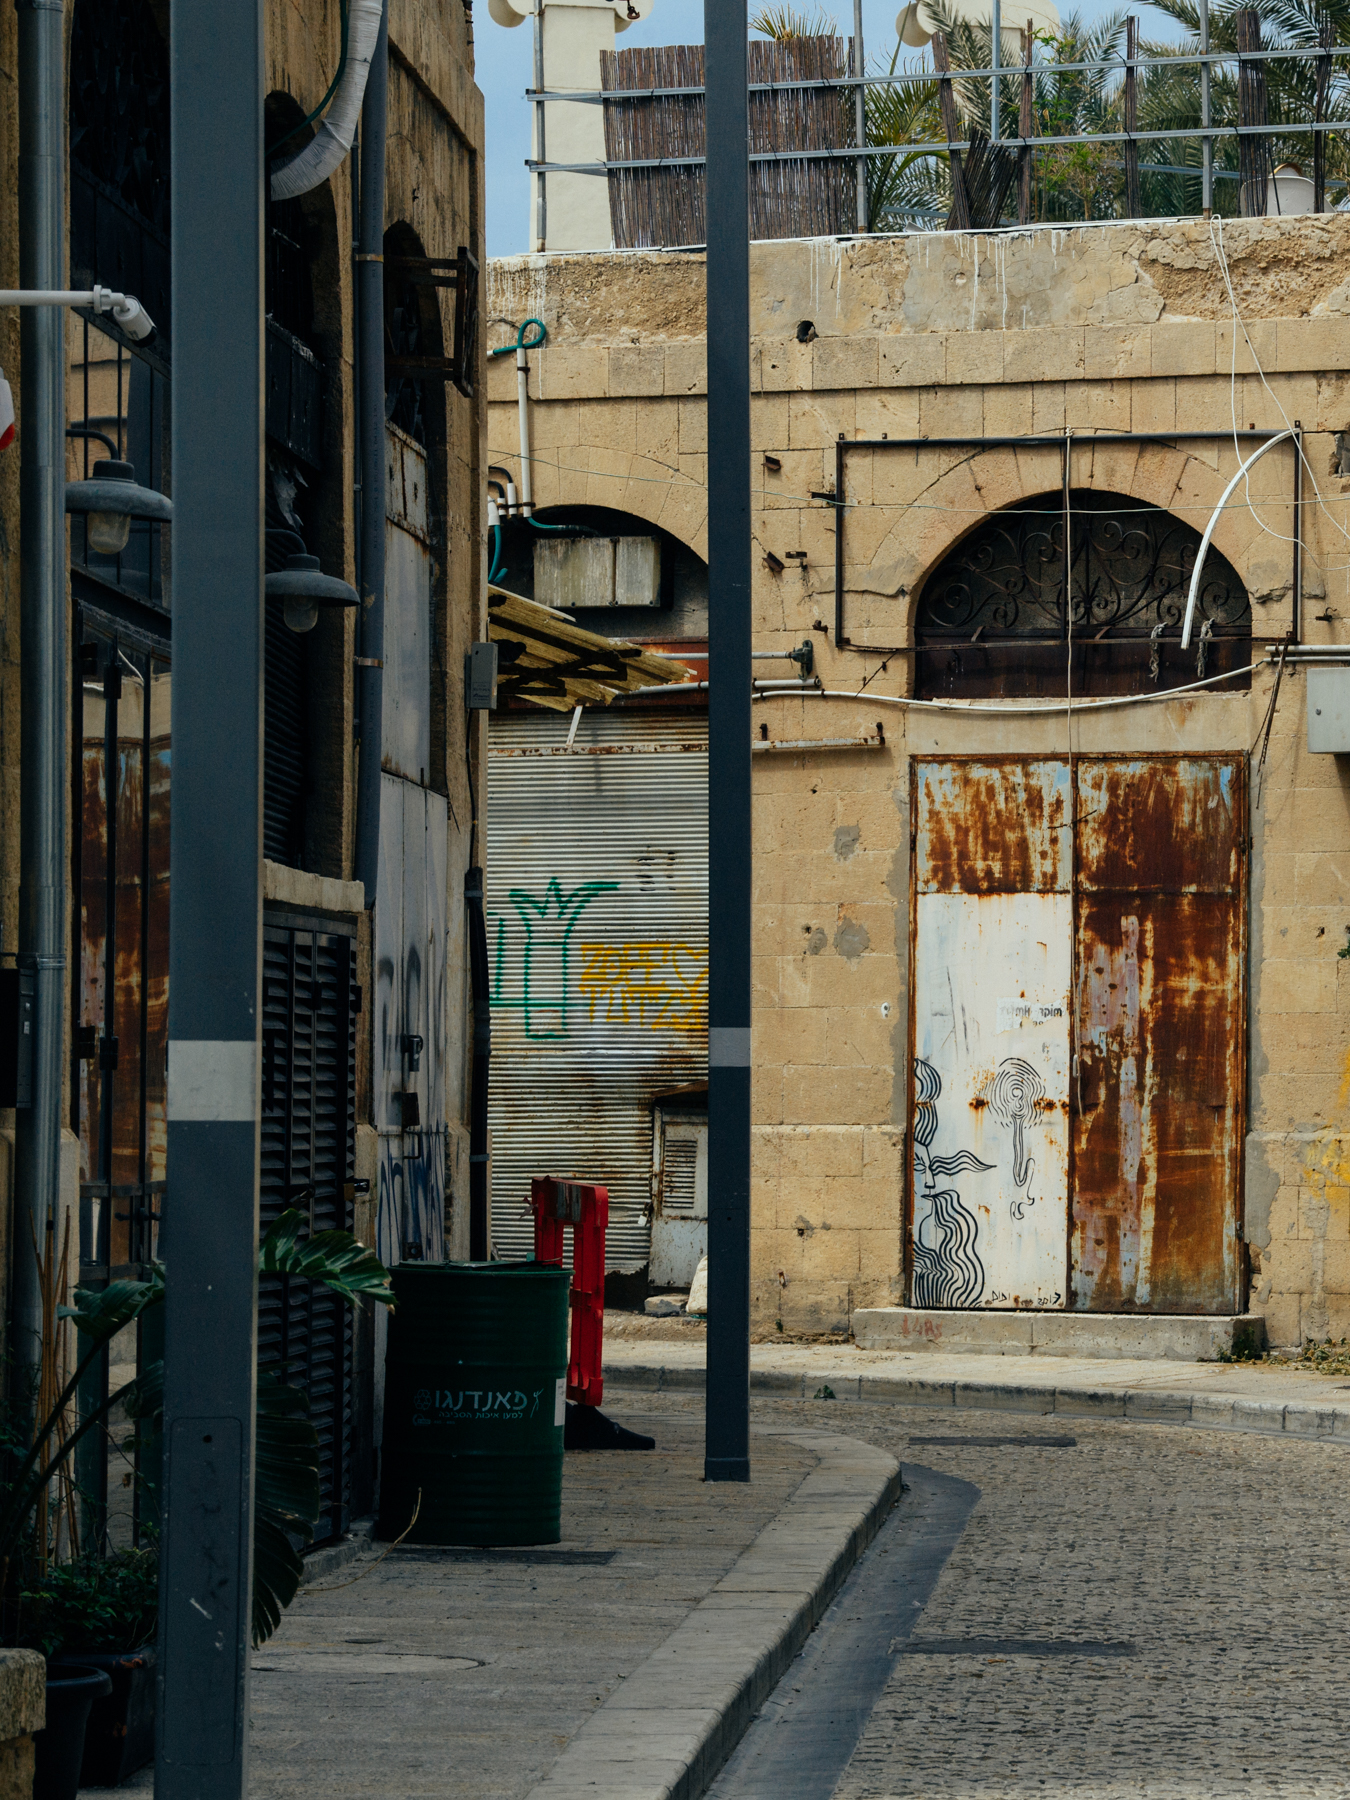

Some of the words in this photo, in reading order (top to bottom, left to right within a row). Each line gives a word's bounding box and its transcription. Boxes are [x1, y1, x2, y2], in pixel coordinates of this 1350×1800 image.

[434, 1389, 528, 1412] פאנדנגו
[438, 1411, 473, 1419] הסביבה
[475, 1411, 500, 1420] איכות
[503, 1410, 523, 1420] למען
